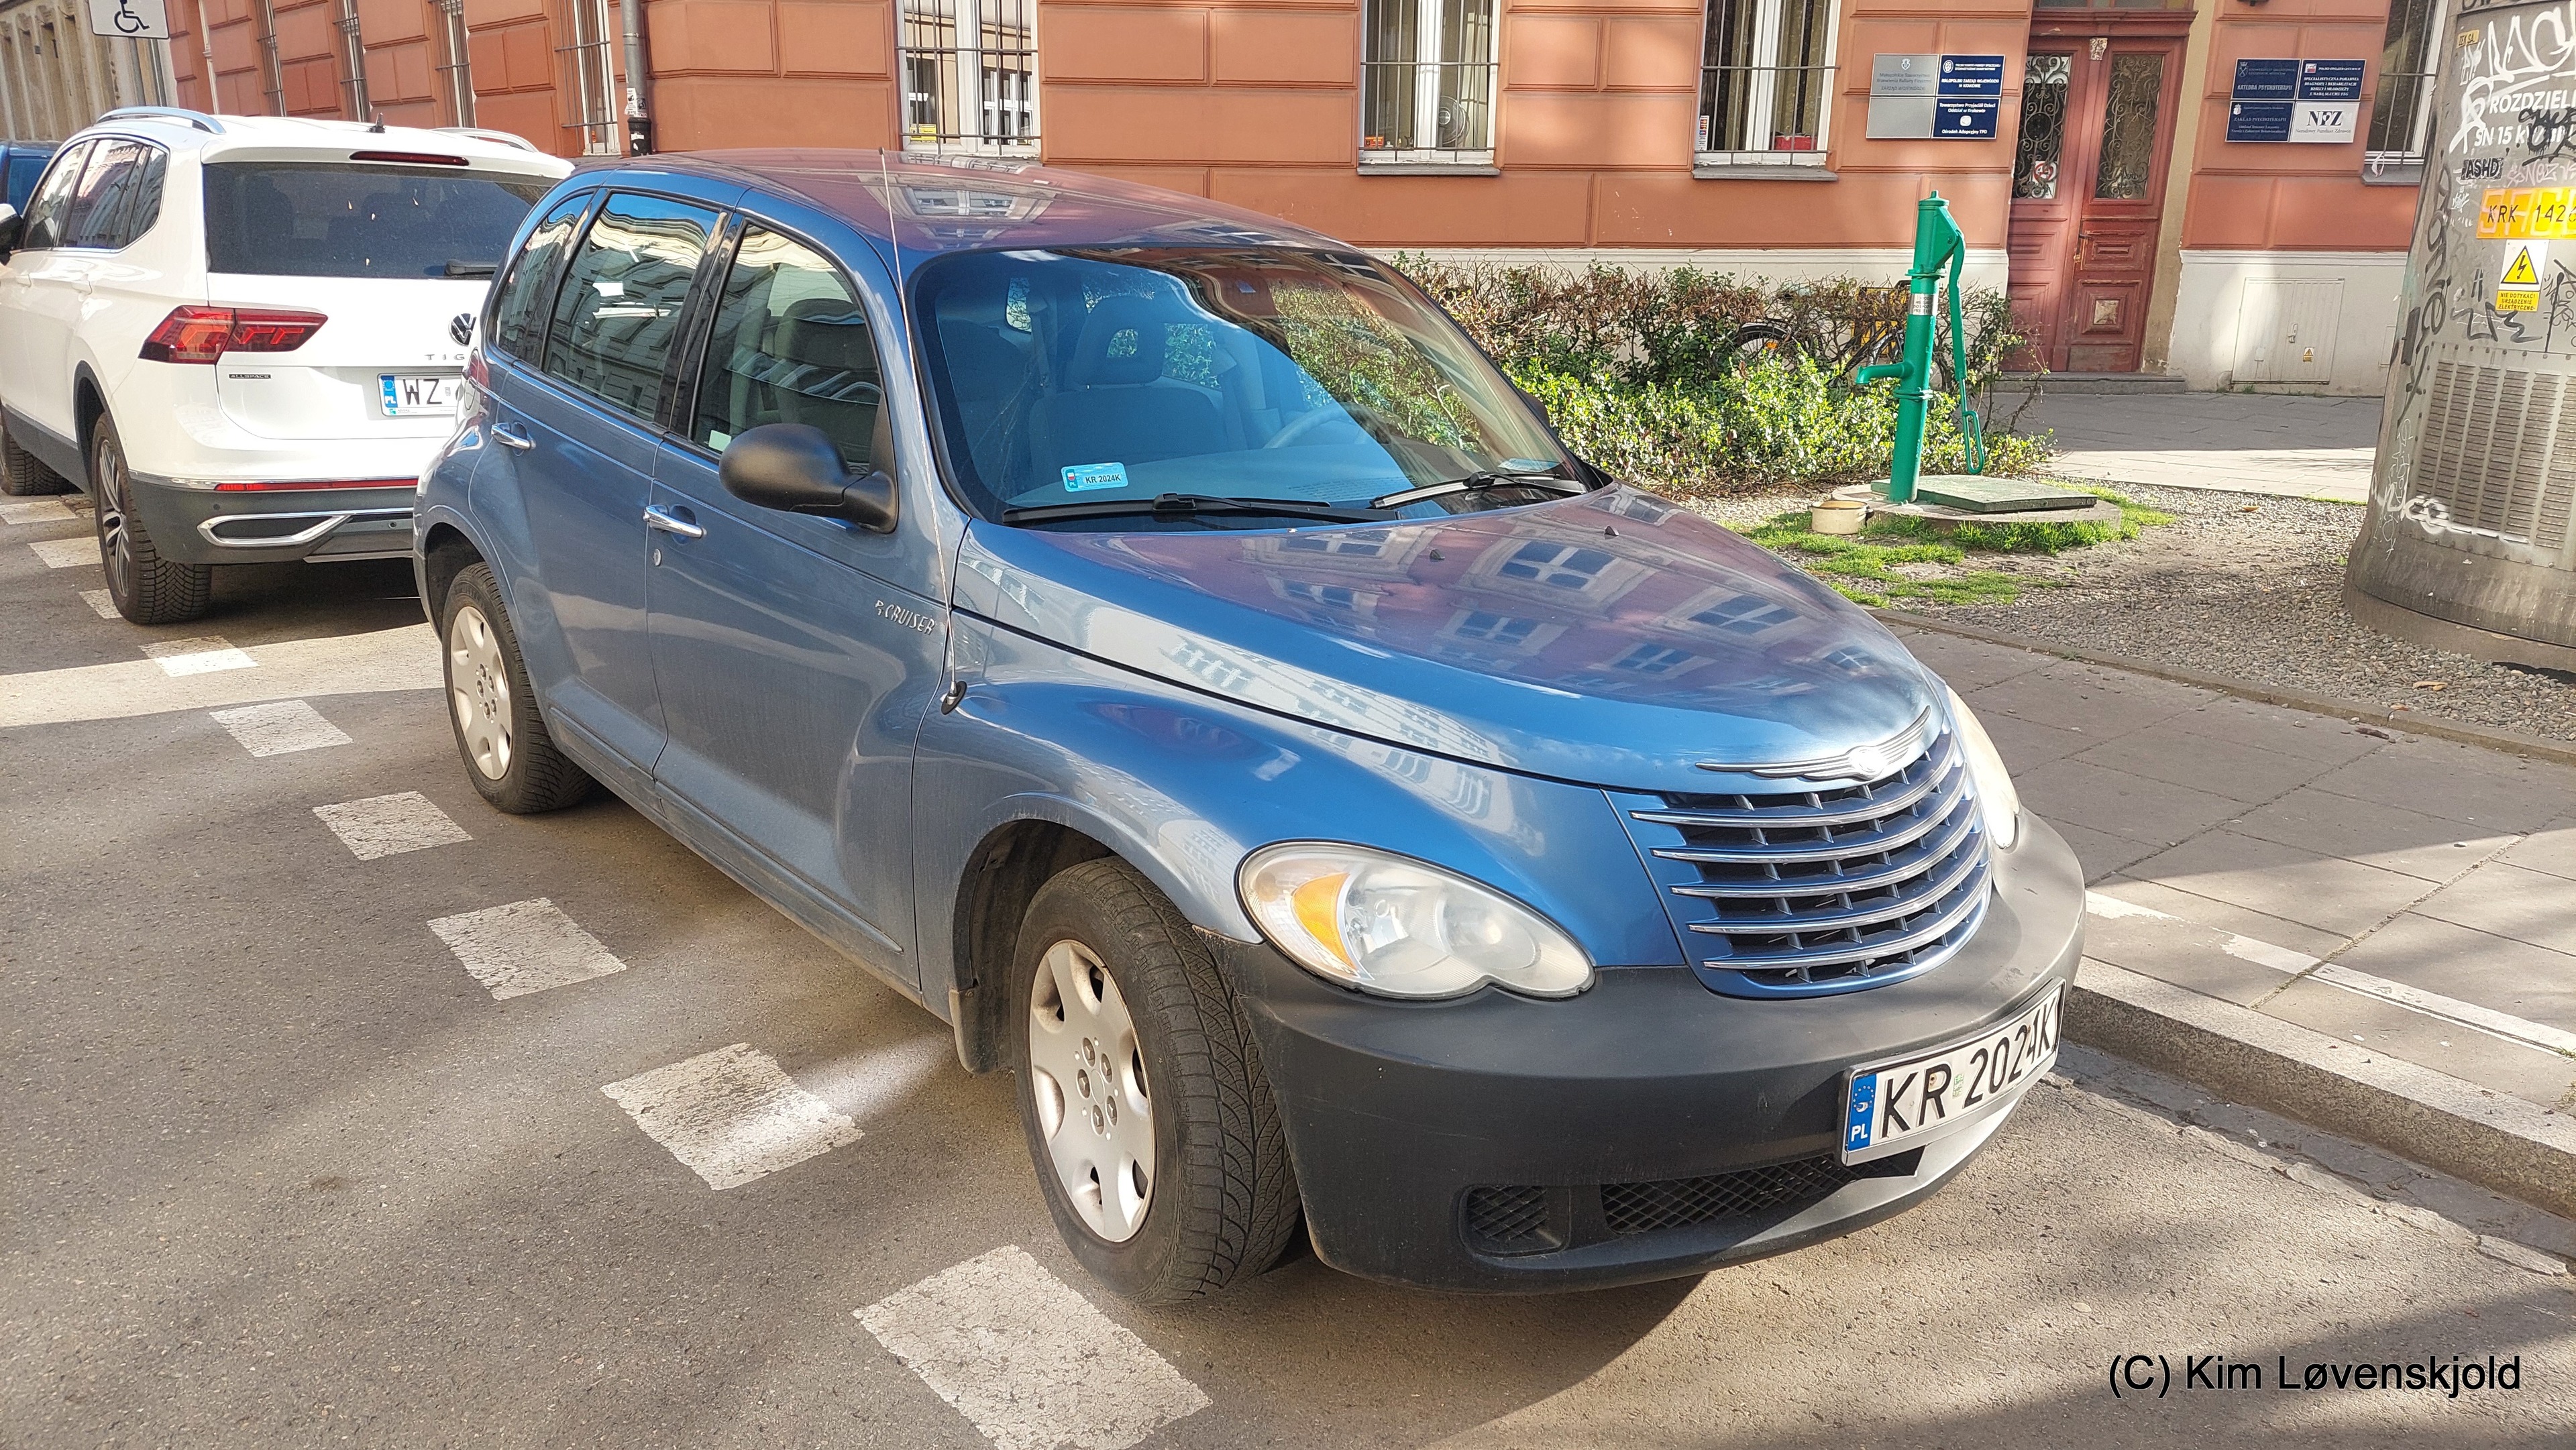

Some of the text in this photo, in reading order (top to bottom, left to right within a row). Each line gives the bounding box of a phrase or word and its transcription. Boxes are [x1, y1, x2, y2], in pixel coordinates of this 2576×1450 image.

[2307, 111, 2343, 126] NFZ
[2474, 127, 2494, 147] SN
[2498, 125, 2514, 145] 15
[2487, 205, 2519, 223] KRK
[385, 379, 442, 405] PL WZ
[1098, 474, 1121, 483] 2024K
[885, 604, 935, 635] CRUISER
[1851, 995, 2057, 1141] PL KR 2024K
